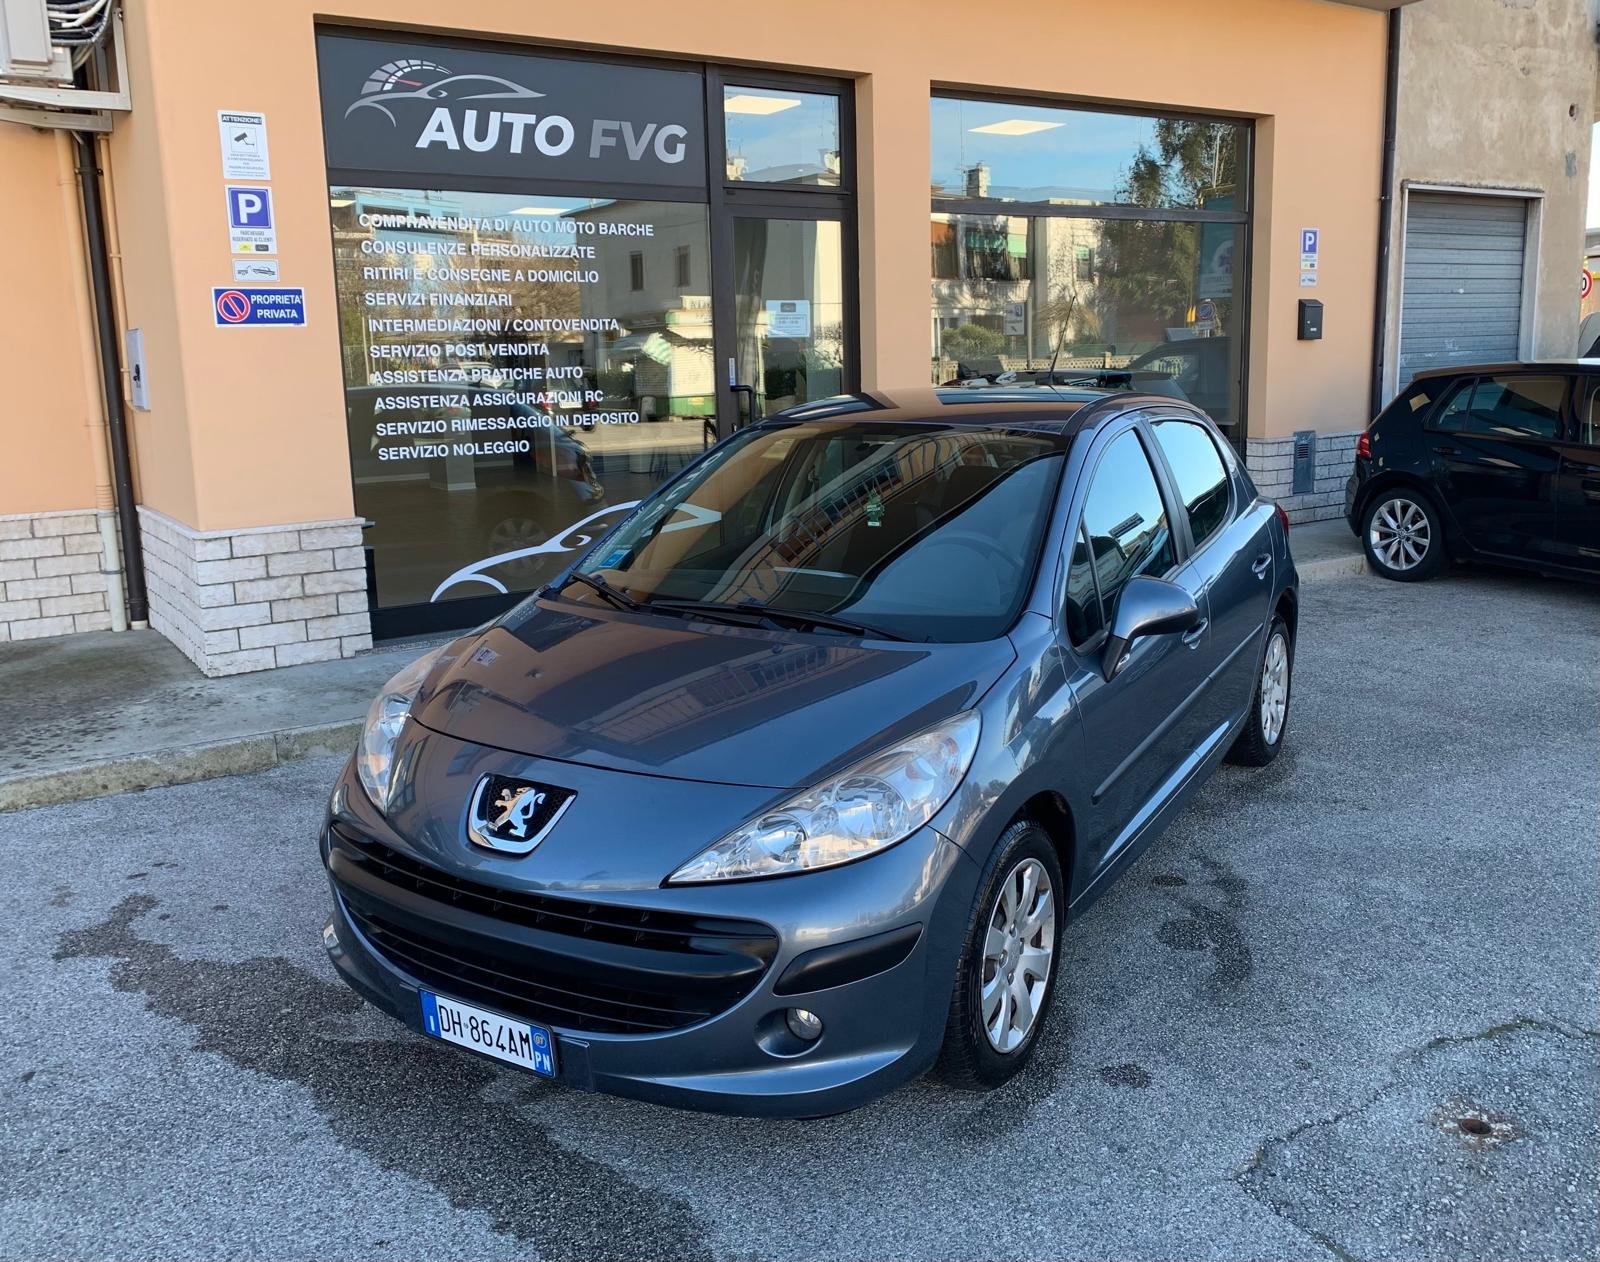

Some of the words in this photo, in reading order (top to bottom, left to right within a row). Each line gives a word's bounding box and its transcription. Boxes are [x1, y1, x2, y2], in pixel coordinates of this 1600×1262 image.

[415, 107, 575, 157] AUTO
[589, 119, 688, 164] FVG
[238, 193, 262, 224] P
[358, 213, 491, 231] COMPRAVENDITA
[494, 218, 509, 232] DI
[512, 220, 551, 234] AUTO
[555, 221, 596, 235] MOTO
[599, 222, 654, 236] BARCHE
[361, 240, 467, 256] CONSULENZE
[470, 243, 596, 259] PERSONALIZZATE
[1305, 232, 1315, 251] P
[363, 266, 409, 281] RITIRI
[414, 267, 424, 281] E
[427, 267, 511, 282] CONSEGNE
[515, 270, 525, 282] A
[528, 270, 599, 283] DOMICILIO
[250, 294, 302, 305] PROPRIETA'
[365, 292, 426, 306] SERVIZI
[430, 292, 513, 306] FINANZIARI
[256, 308, 298, 319] PRIVATA
[368, 318, 501, 332] INTERMEDIAZIONI
[504, 318, 510, 332] /
[513, 318, 620, 332] CONTOVENDITA
[370, 344, 441, 358] SERVIZIO
[445, 343, 485, 358] POST
[489, 343, 550, 357] VENDITA
[372, 369, 469, 385] ASSISTENZA
[471, 367, 543, 382] PRATICHE
[545, 366, 584, 380] AUTO
[374, 394, 469, 410] ASSISTENZA
[473, 391, 582, 407] ASSICURAZIONI
[585, 390, 604, 402] RC
[376, 420, 447, 436] SERVIZIO
[451, 415, 552, 433] RIMESSAGGIO
[556, 414, 570, 427] IN
[573, 411, 639, 427] DEPOSITO
[378, 443, 449, 461] SERVIZIO
[453, 440, 530, 458] NOLEGGIO
[438, 1004, 463, 1038] DH
[468, 1016, 533, 1061] 864AM
[534, 1051, 552, 1072] PN
